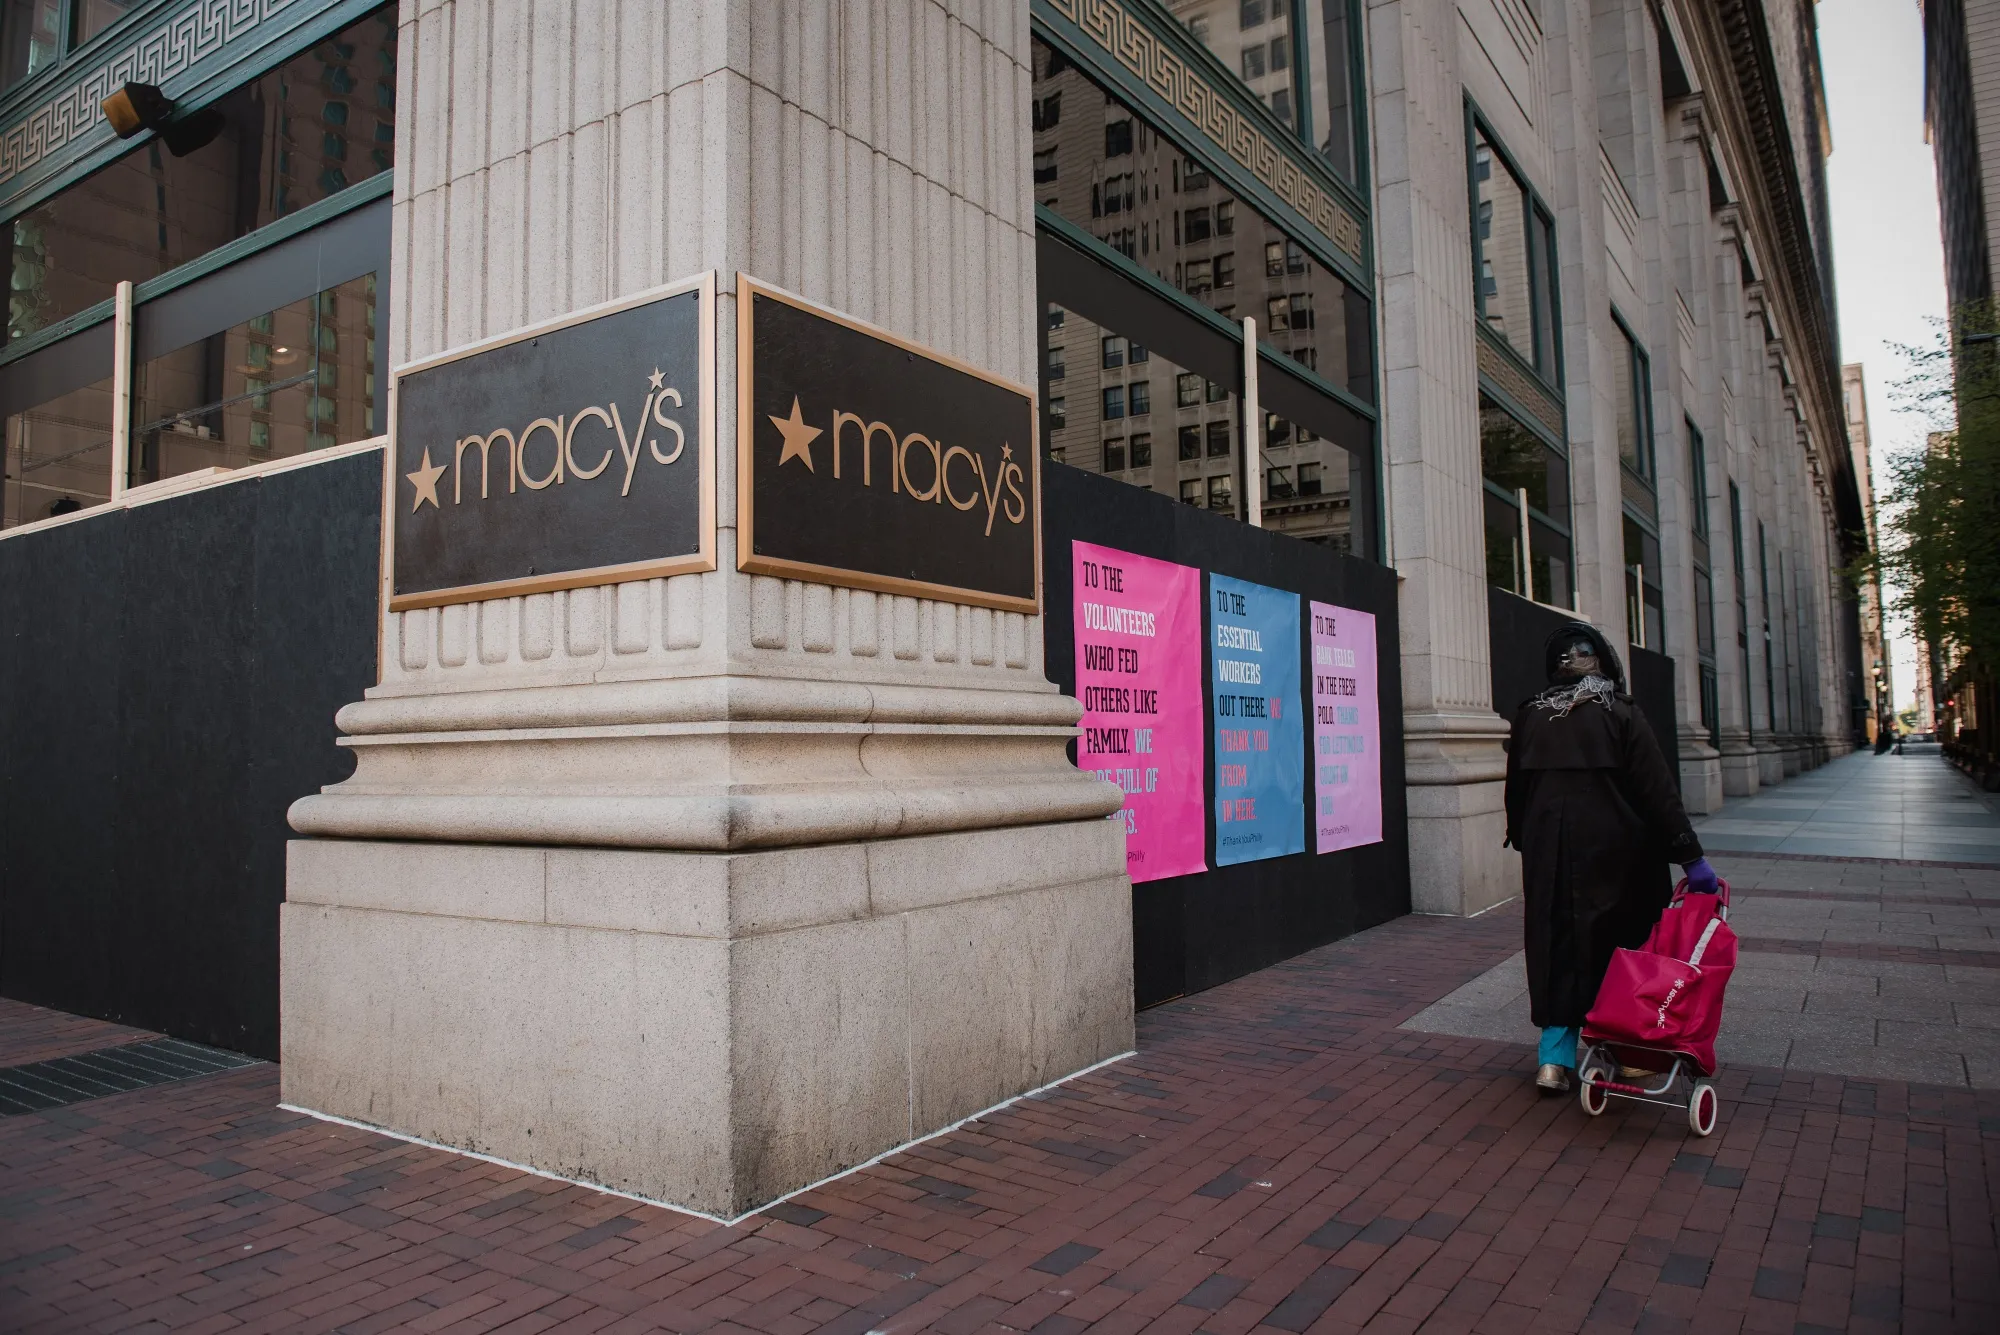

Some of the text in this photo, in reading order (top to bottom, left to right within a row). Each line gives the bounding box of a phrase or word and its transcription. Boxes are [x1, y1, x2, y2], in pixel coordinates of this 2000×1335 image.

[1083, 561, 1123, 593] TO THE
[1217, 589, 1246, 616] TO THE
[1083, 602, 1155, 637] VOLUNTEERS
[1315, 615, 1336, 637] TO THE
[1217, 624, 1262, 652] ESSENTIAL
[1084, 644, 1138, 673] WHO FED
[1218, 660, 1261, 685] WORKERS
[1317, 676, 1356, 696] IN THE FRESH
[1085, 686, 1158, 714] OTHERS LIKE
[1219, 695, 1236, 716] OUT
[1239, 695, 1267, 720] THERE,
[1086, 728, 1153, 756] FAMILY, WE
[1220, 729, 1269, 752] THANK YOU
[1116, 768, 1142, 794] FULL
[1145, 767, 1158, 792] OF
[1221, 764, 1247, 787] FROM
[1222, 800, 1232, 823] IN
